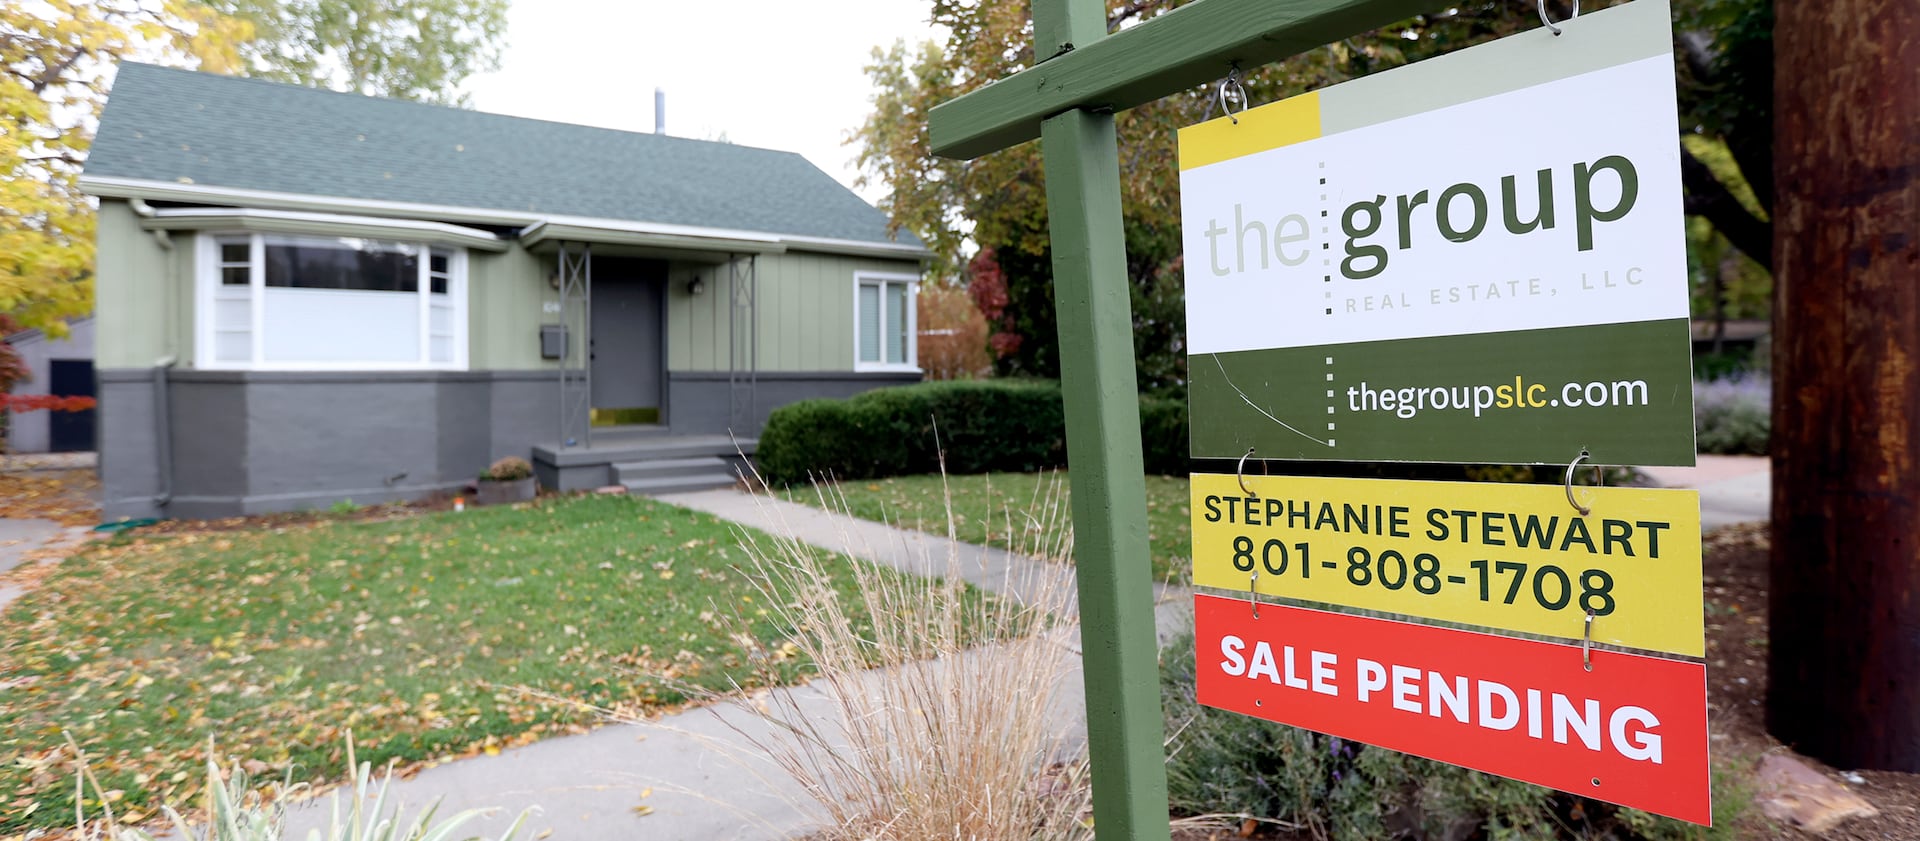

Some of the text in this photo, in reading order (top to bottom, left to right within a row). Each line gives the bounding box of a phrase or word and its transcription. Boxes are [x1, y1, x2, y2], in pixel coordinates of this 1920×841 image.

[1204, 154, 1639, 280] the group
[1346, 266, 1645, 314] REAL ESTATE, LLC
[1347, 375, 1649, 418] thegroupslc.com
[1204, 494, 1671, 560] STEPHANIE STEWART
[1232, 535, 1616, 617] 801-808-1708
[1220, 635, 1663, 764] SALE PENDING
